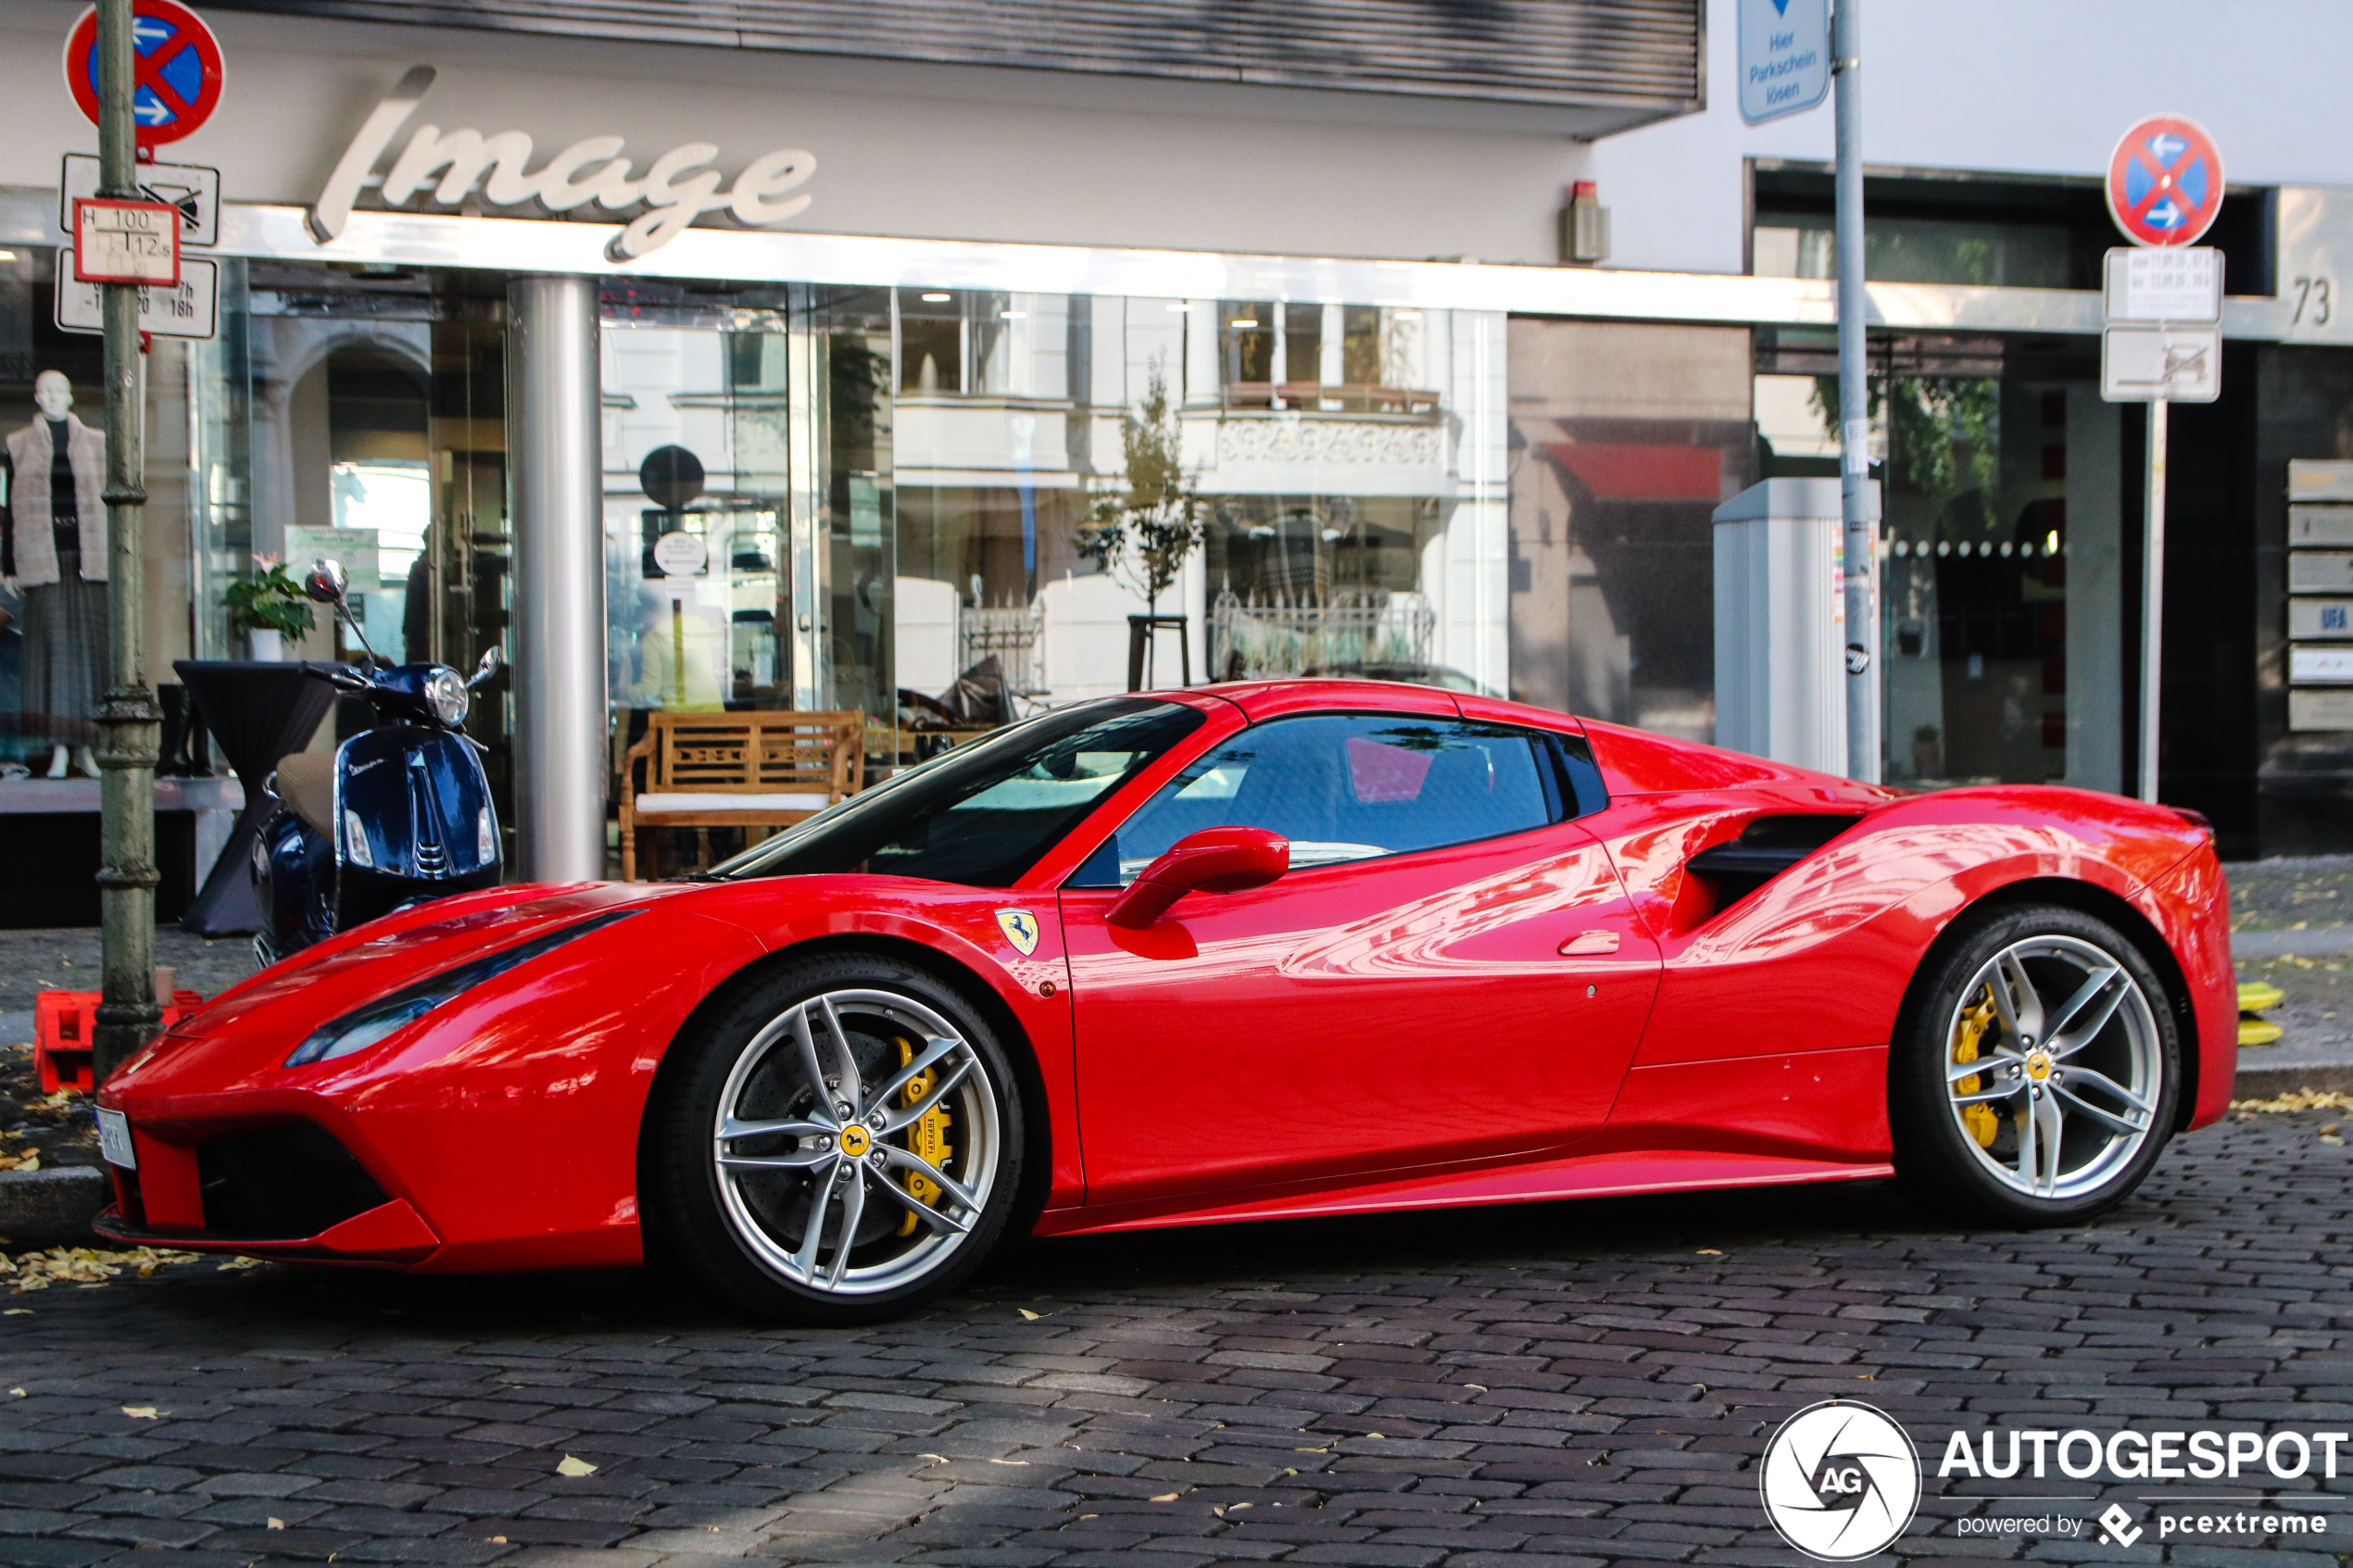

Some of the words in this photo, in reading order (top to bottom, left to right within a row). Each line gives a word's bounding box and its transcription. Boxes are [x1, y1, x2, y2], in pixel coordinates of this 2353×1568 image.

[1770, 31, 1793, 53] Hier
[1750, 50, 1816, 83] Parkschein
[1767, 81, 1799, 105] lösen
[304, 64, 817, 263] Image
[82, 208, 95, 225] H
[115, 209, 148, 230] 100
[171, 298, 194, 319] 18h
[2293, 277, 2330, 325] 73
